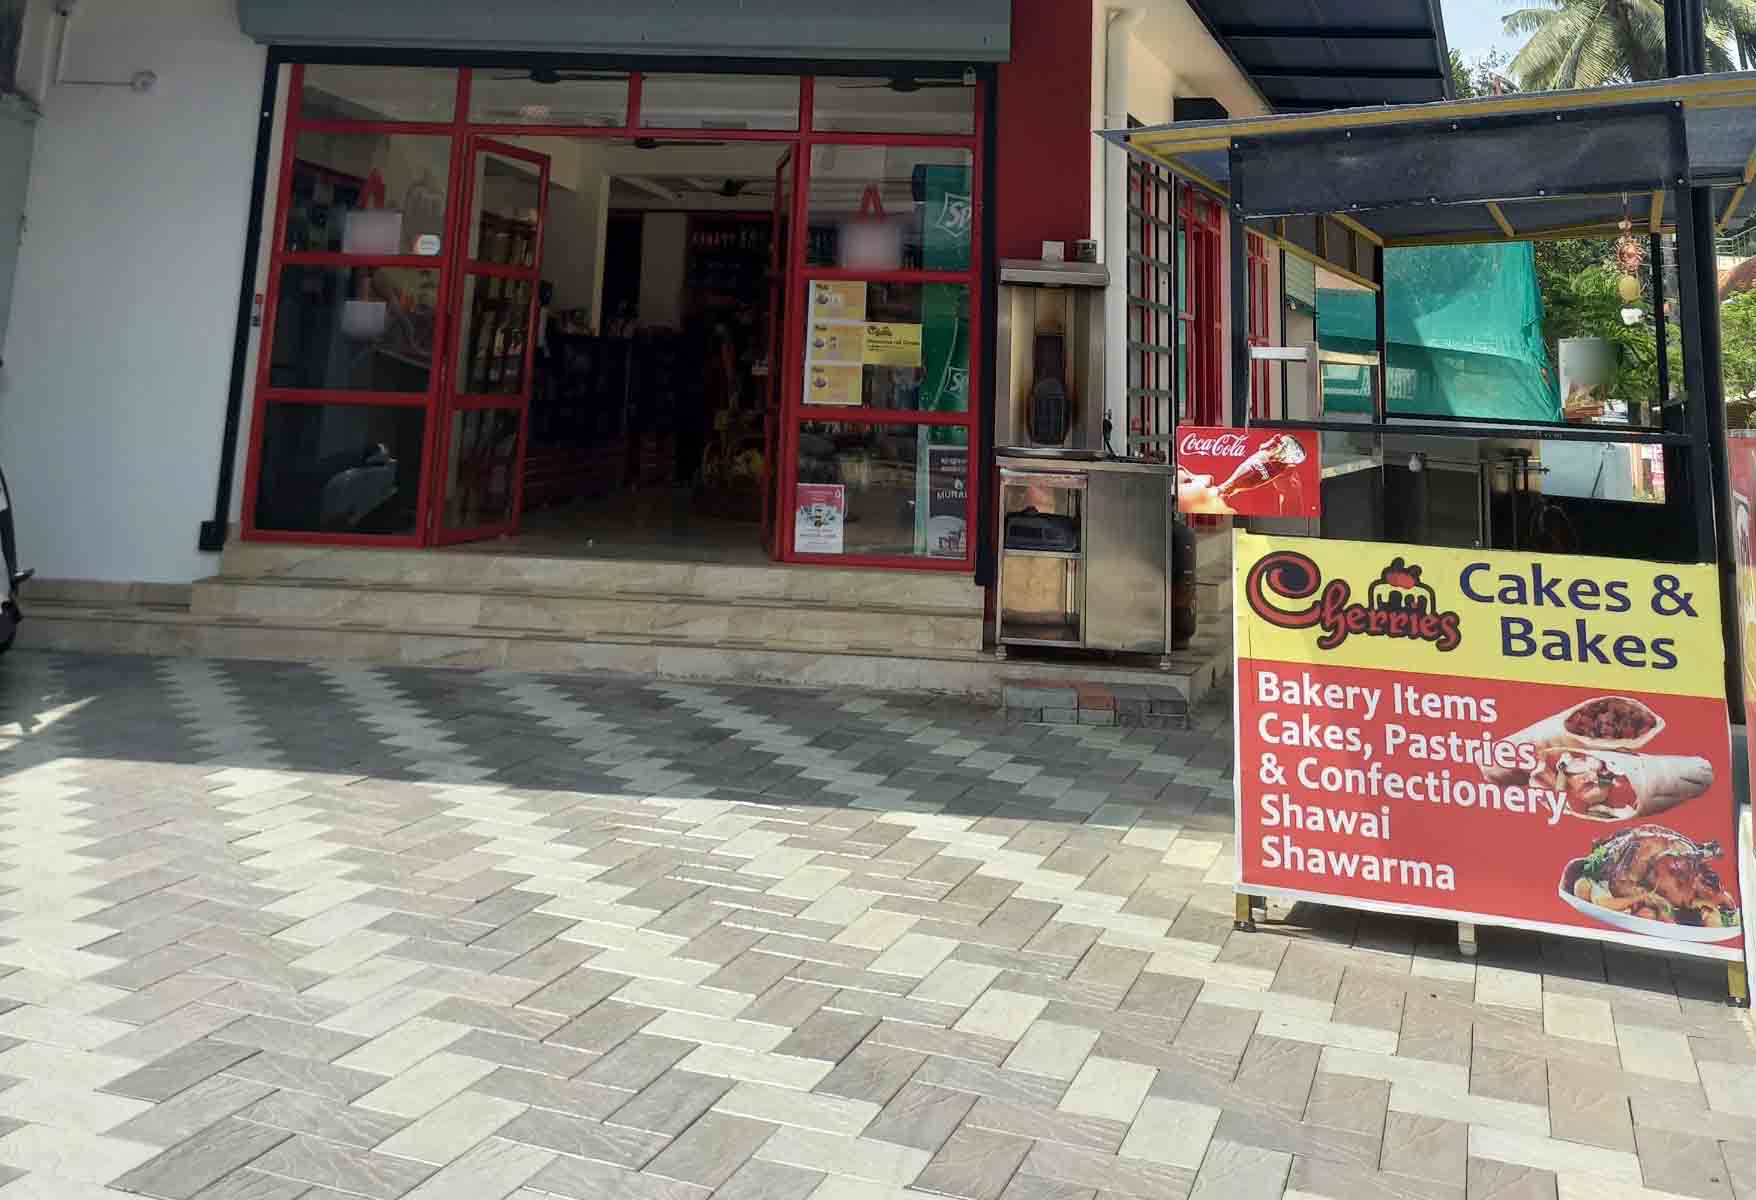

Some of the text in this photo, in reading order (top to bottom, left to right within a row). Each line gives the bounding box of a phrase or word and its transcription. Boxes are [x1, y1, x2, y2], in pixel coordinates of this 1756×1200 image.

[1246, 550, 1462, 652] Cherries
[1459, 562, 1699, 618] Cakes &
[1500, 616, 1678, 670] Bakes
[1257, 671, 1498, 723] Bakery Items
[1257, 712, 1537, 770] Cakes, Pastries
[1259, 752, 1567, 825] & Confectionery
[1260, 793, 1391, 841] Shawai
[1261, 835, 1456, 891] Shawarma
